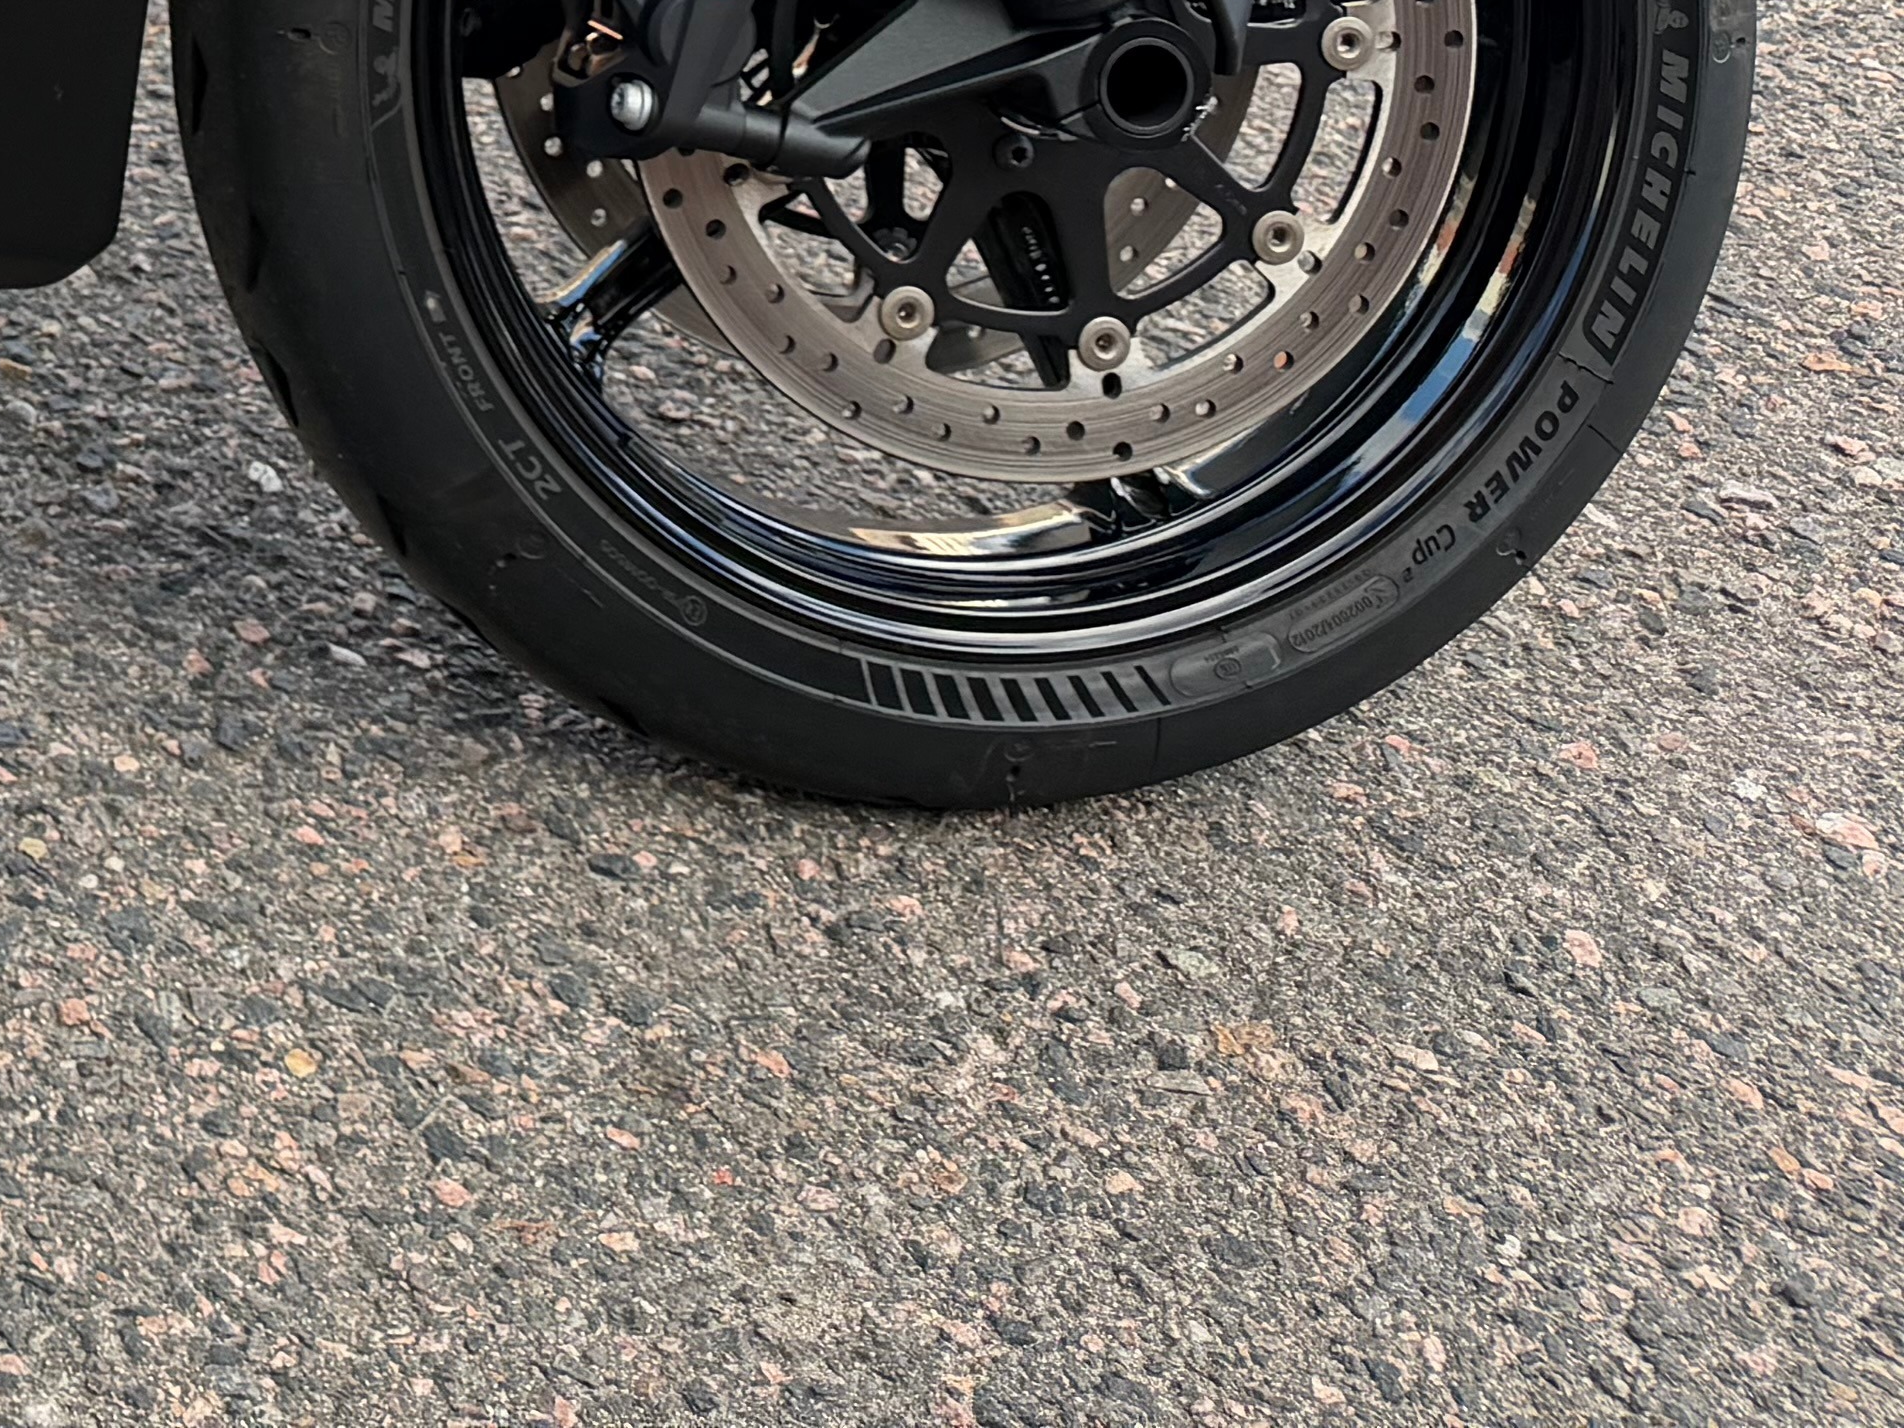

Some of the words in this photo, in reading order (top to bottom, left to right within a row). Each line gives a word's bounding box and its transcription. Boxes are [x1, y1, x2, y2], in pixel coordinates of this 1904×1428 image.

[1590, 48, 1691, 350] MICHELIN
[438, 331, 495, 412] FRONT
[497, 438, 563, 501] 2CT
[1462, 379, 1581, 524] POWER
